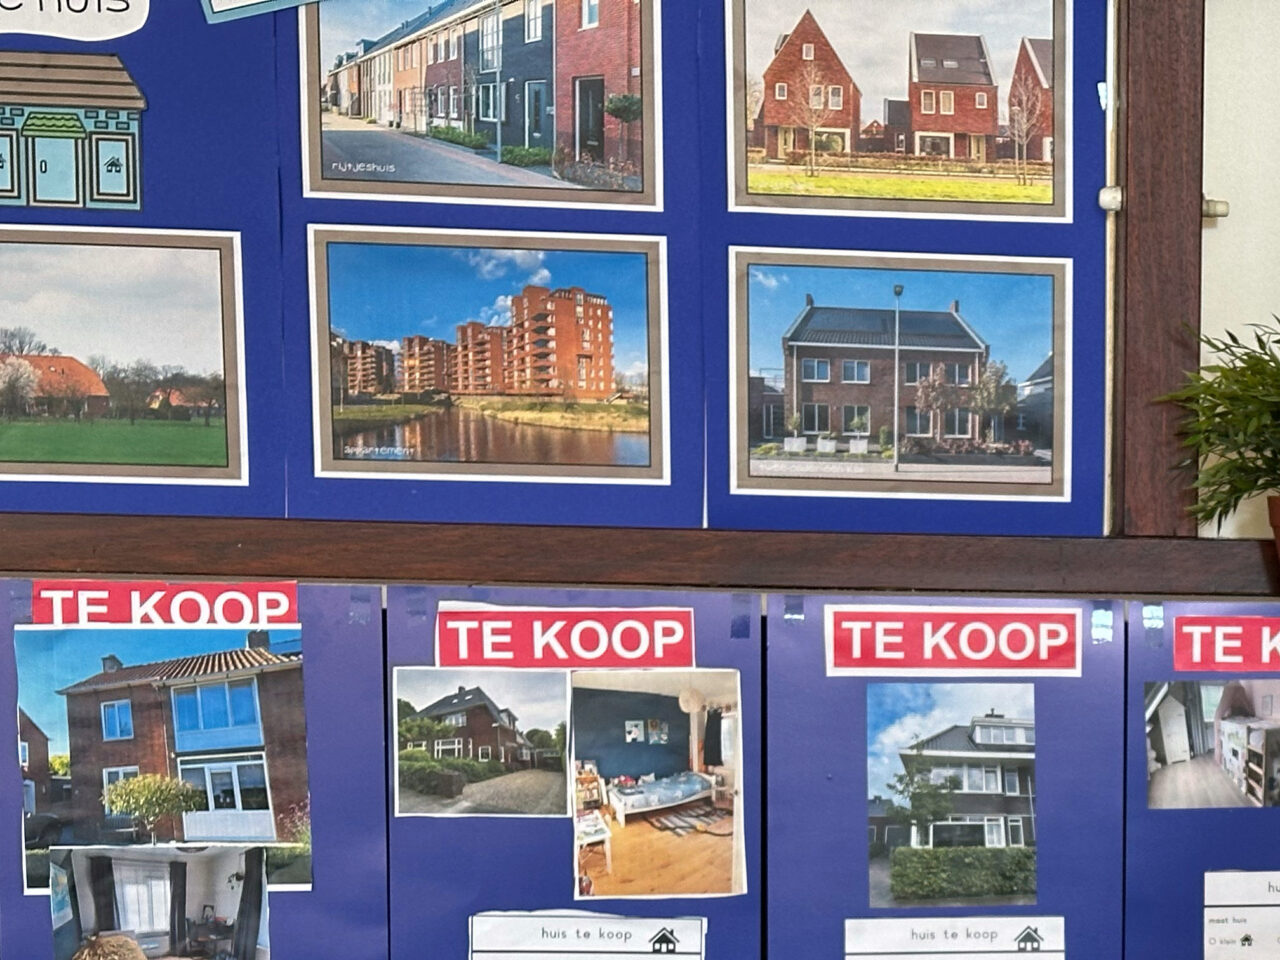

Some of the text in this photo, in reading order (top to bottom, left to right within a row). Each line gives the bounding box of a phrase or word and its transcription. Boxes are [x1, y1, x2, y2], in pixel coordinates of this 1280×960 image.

[331, 162, 396, 173] rijtjeshuis
[131, 591, 290, 627] KOOP
[446, 619, 685, 660] TE KOOP
[841, 621, 1069, 661] TE KOOP
[1182, 625, 1244, 663] TE
[541, 927, 633, 943] huis te koop
[911, 929, 998, 943] huis te koop
